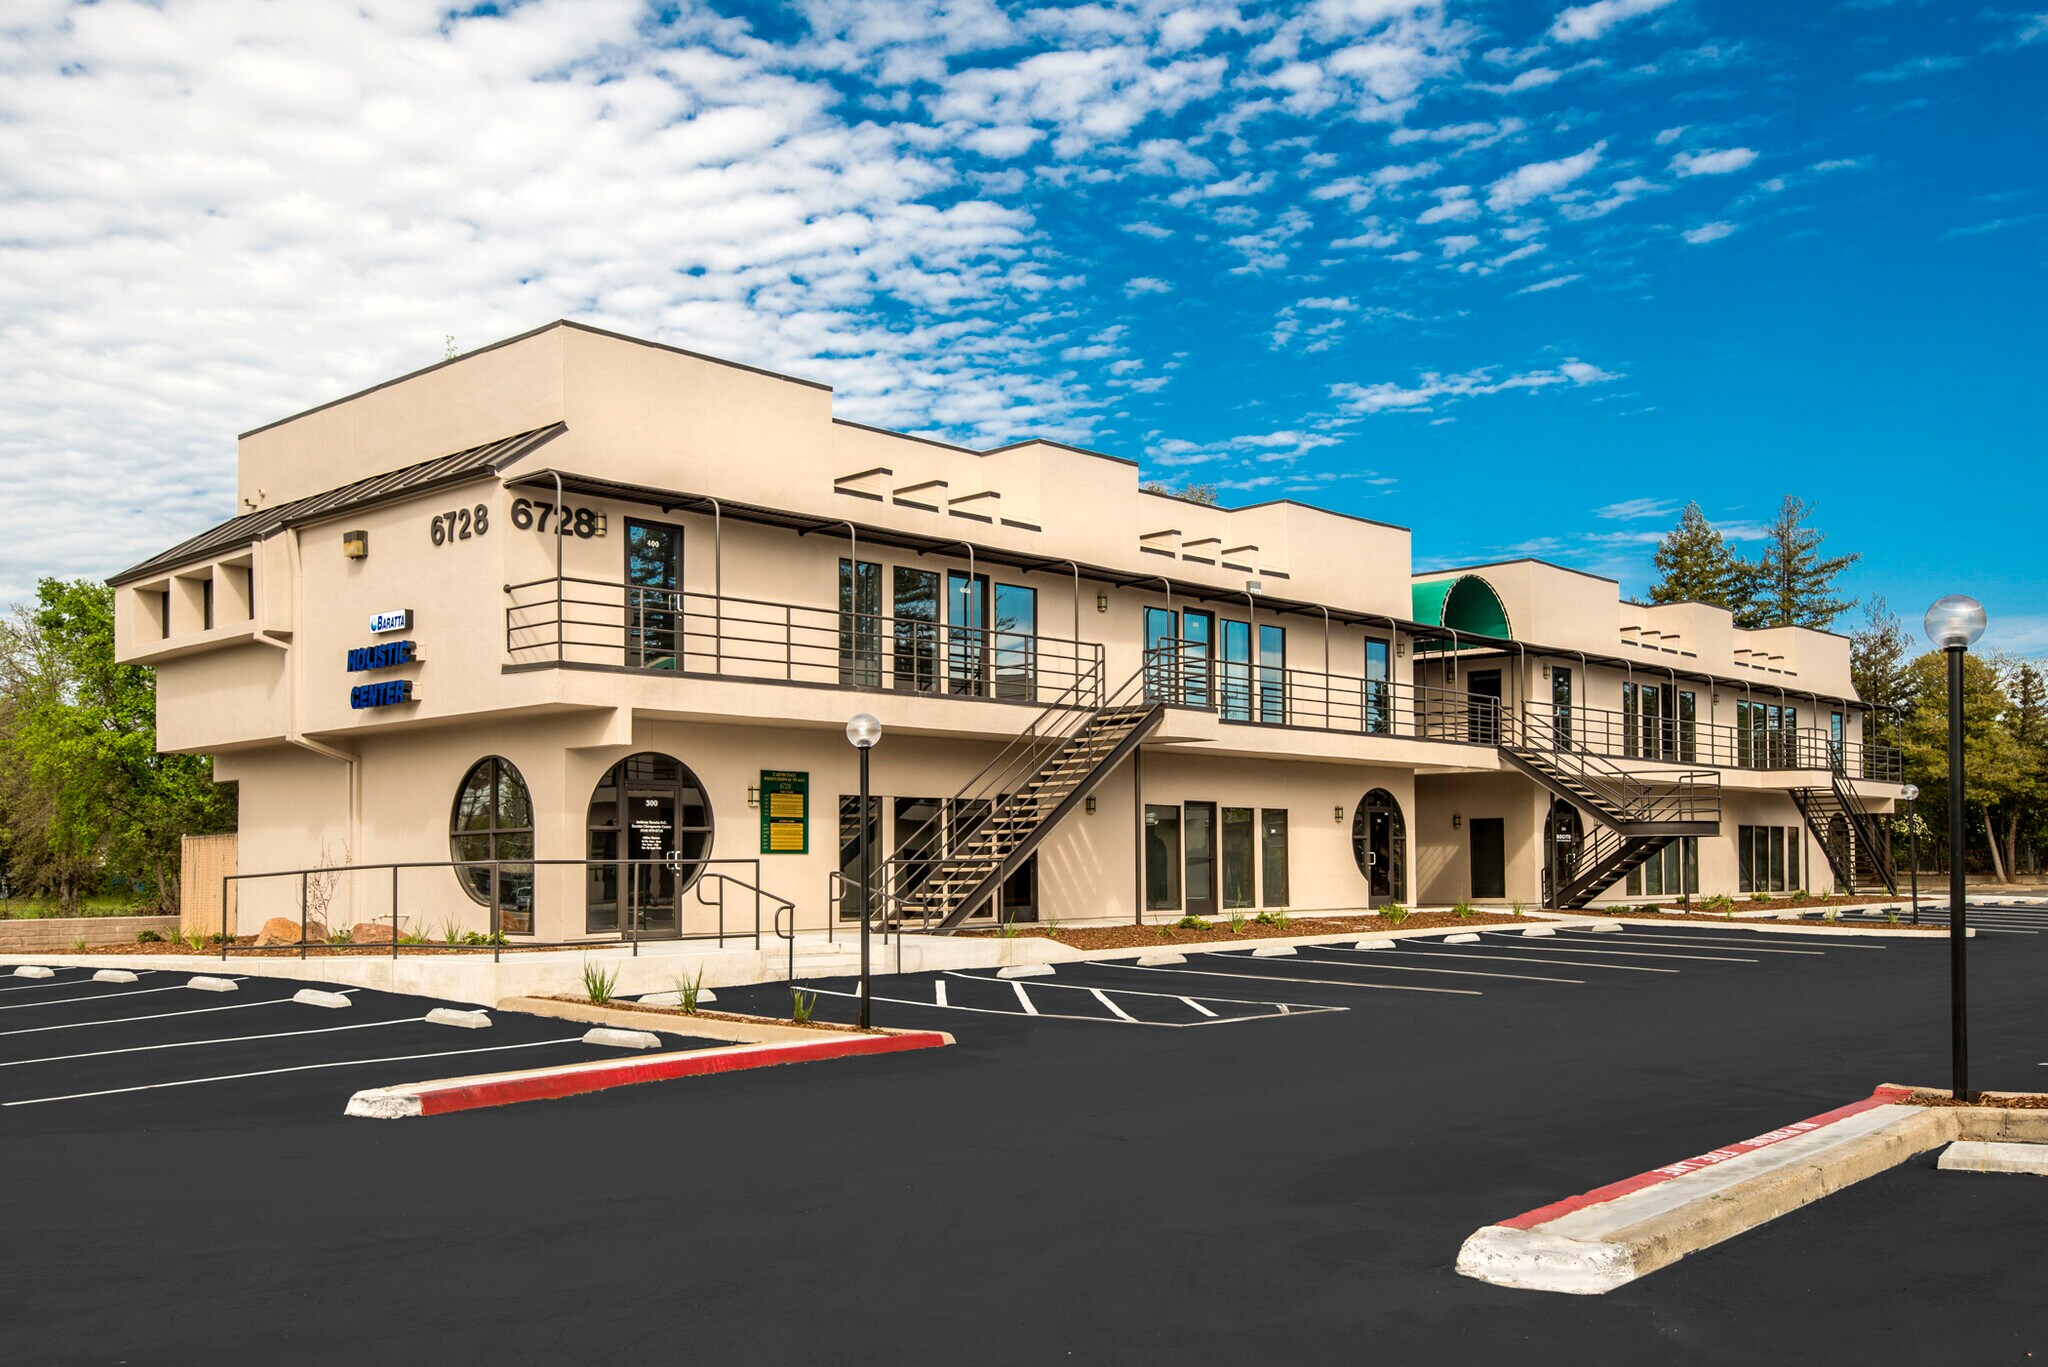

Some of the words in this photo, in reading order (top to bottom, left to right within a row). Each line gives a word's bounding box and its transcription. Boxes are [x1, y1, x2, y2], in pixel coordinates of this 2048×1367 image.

[431, 504, 489, 546] 6728
[511, 498, 596, 539] 6728
[347, 640, 415, 672] HOLISTIC
[351, 680, 411, 709] CENTER
[645, 799, 659, 807] 300
